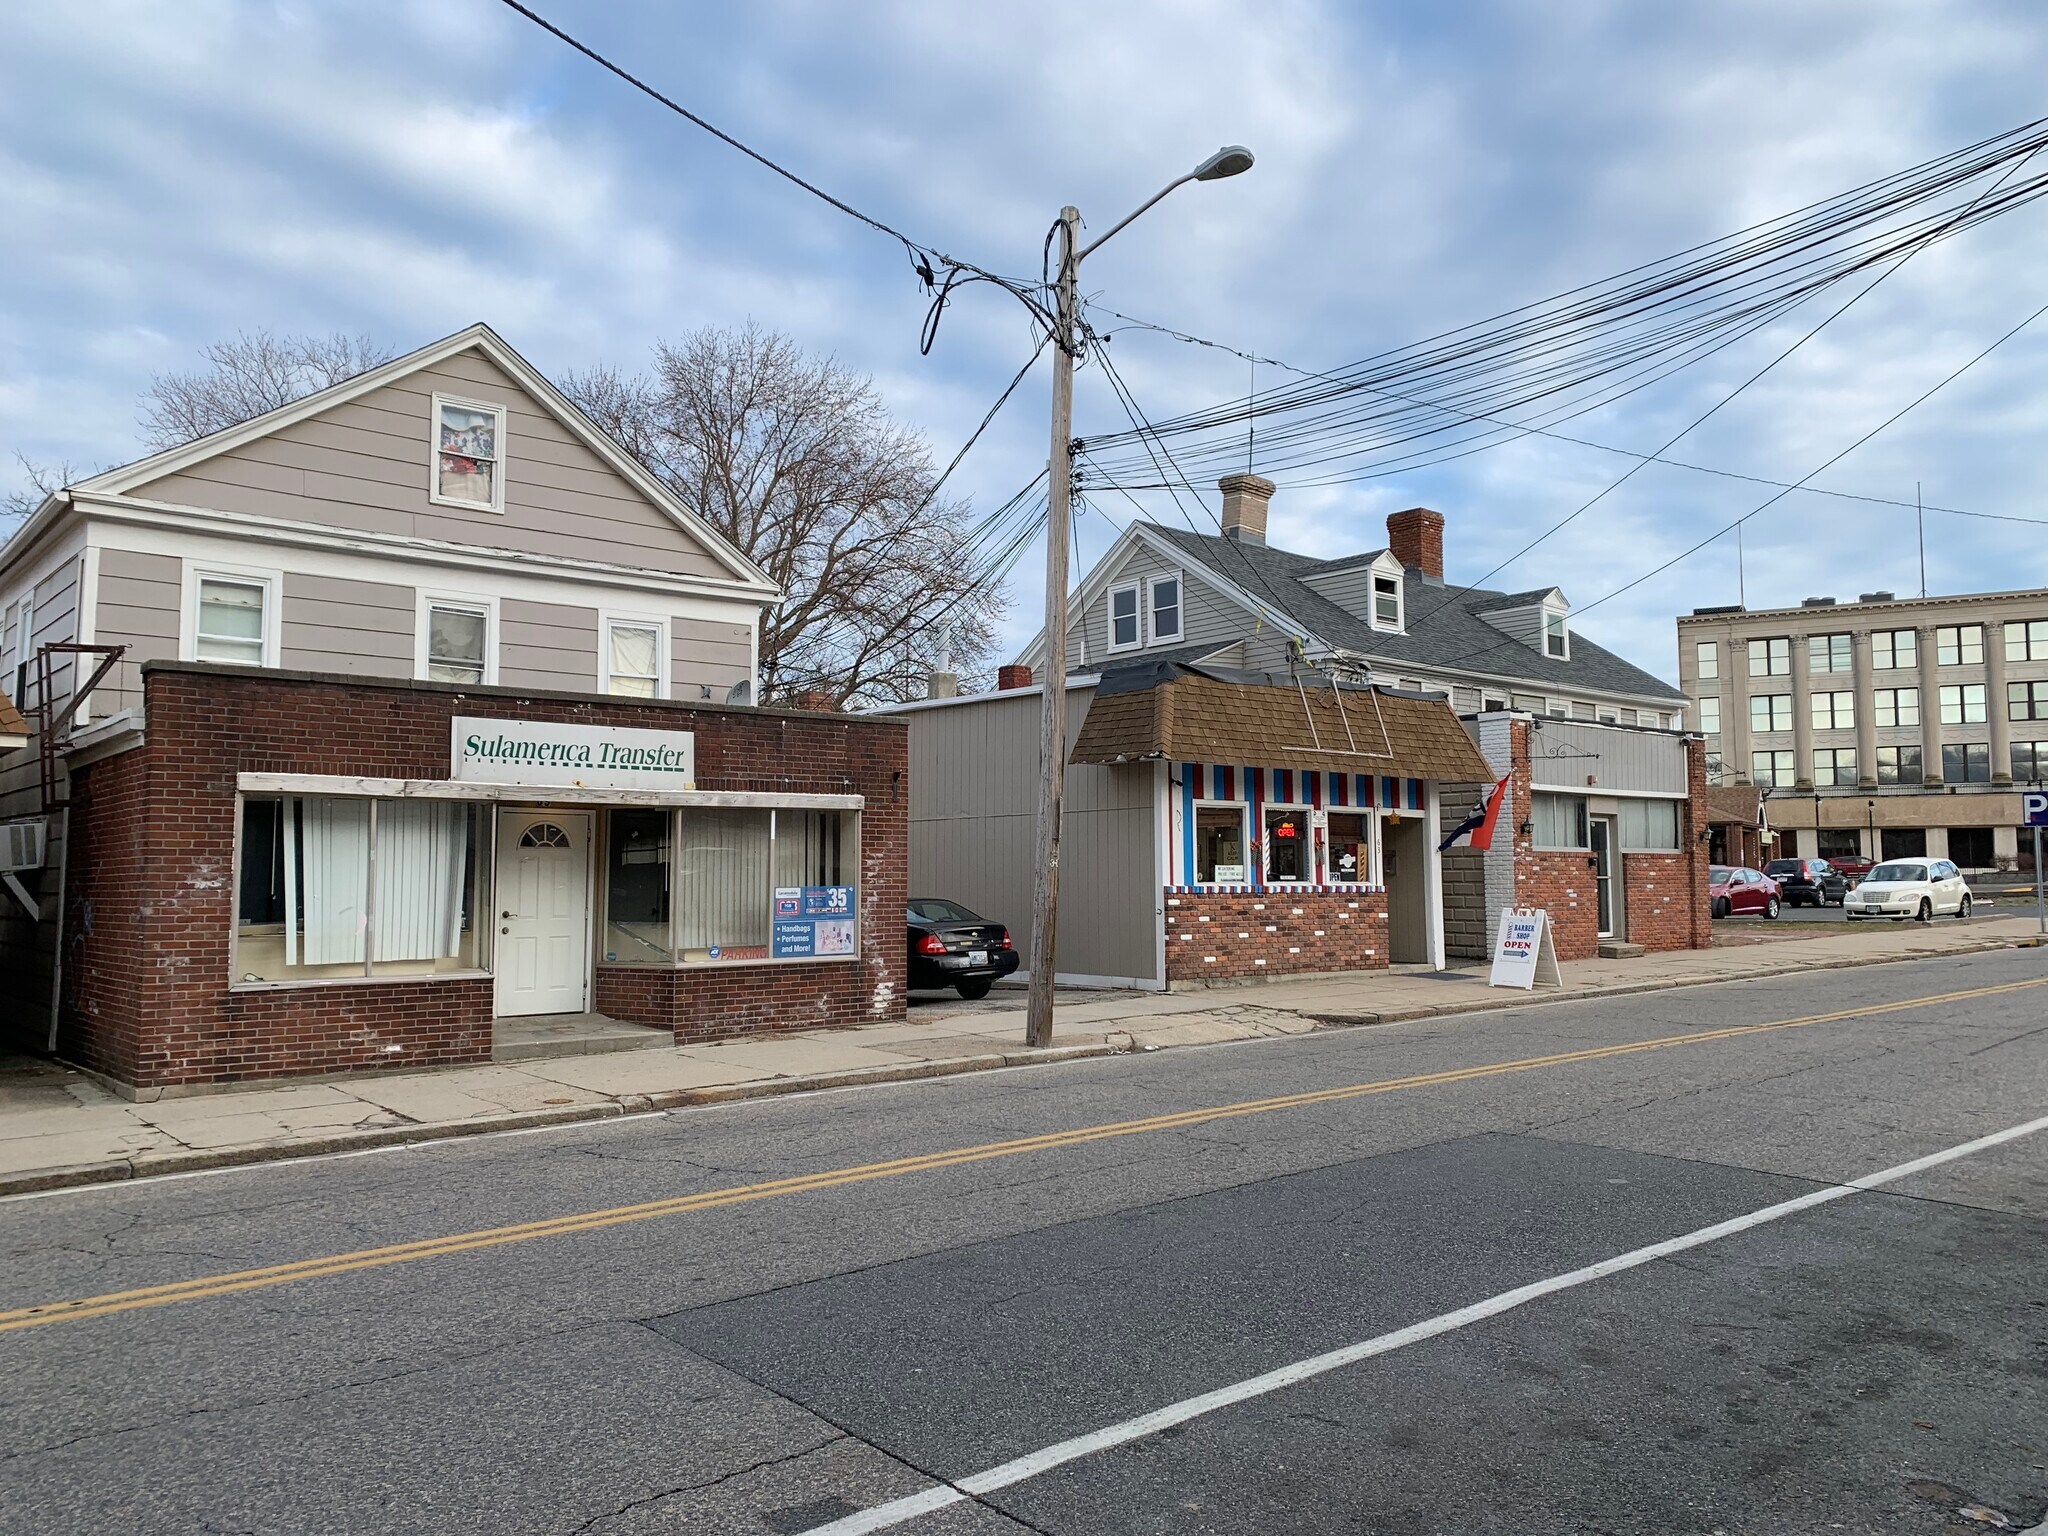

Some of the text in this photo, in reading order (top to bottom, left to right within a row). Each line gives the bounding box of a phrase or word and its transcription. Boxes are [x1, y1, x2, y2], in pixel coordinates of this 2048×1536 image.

[464, 734, 685, 766] Sulamerica Transfer
[2024, 795, 2048, 823] P
[1278, 828, 1295, 837] OPEN
[782, 925, 811, 933] Handbags
[1514, 924, 1535, 932] BARBER
[782, 935, 810, 943] Perfumes
[1516, 932, 1530, 940] SHOP
[781, 944, 811, 953] and More!
[1504, 940, 1532, 949] OPEN
